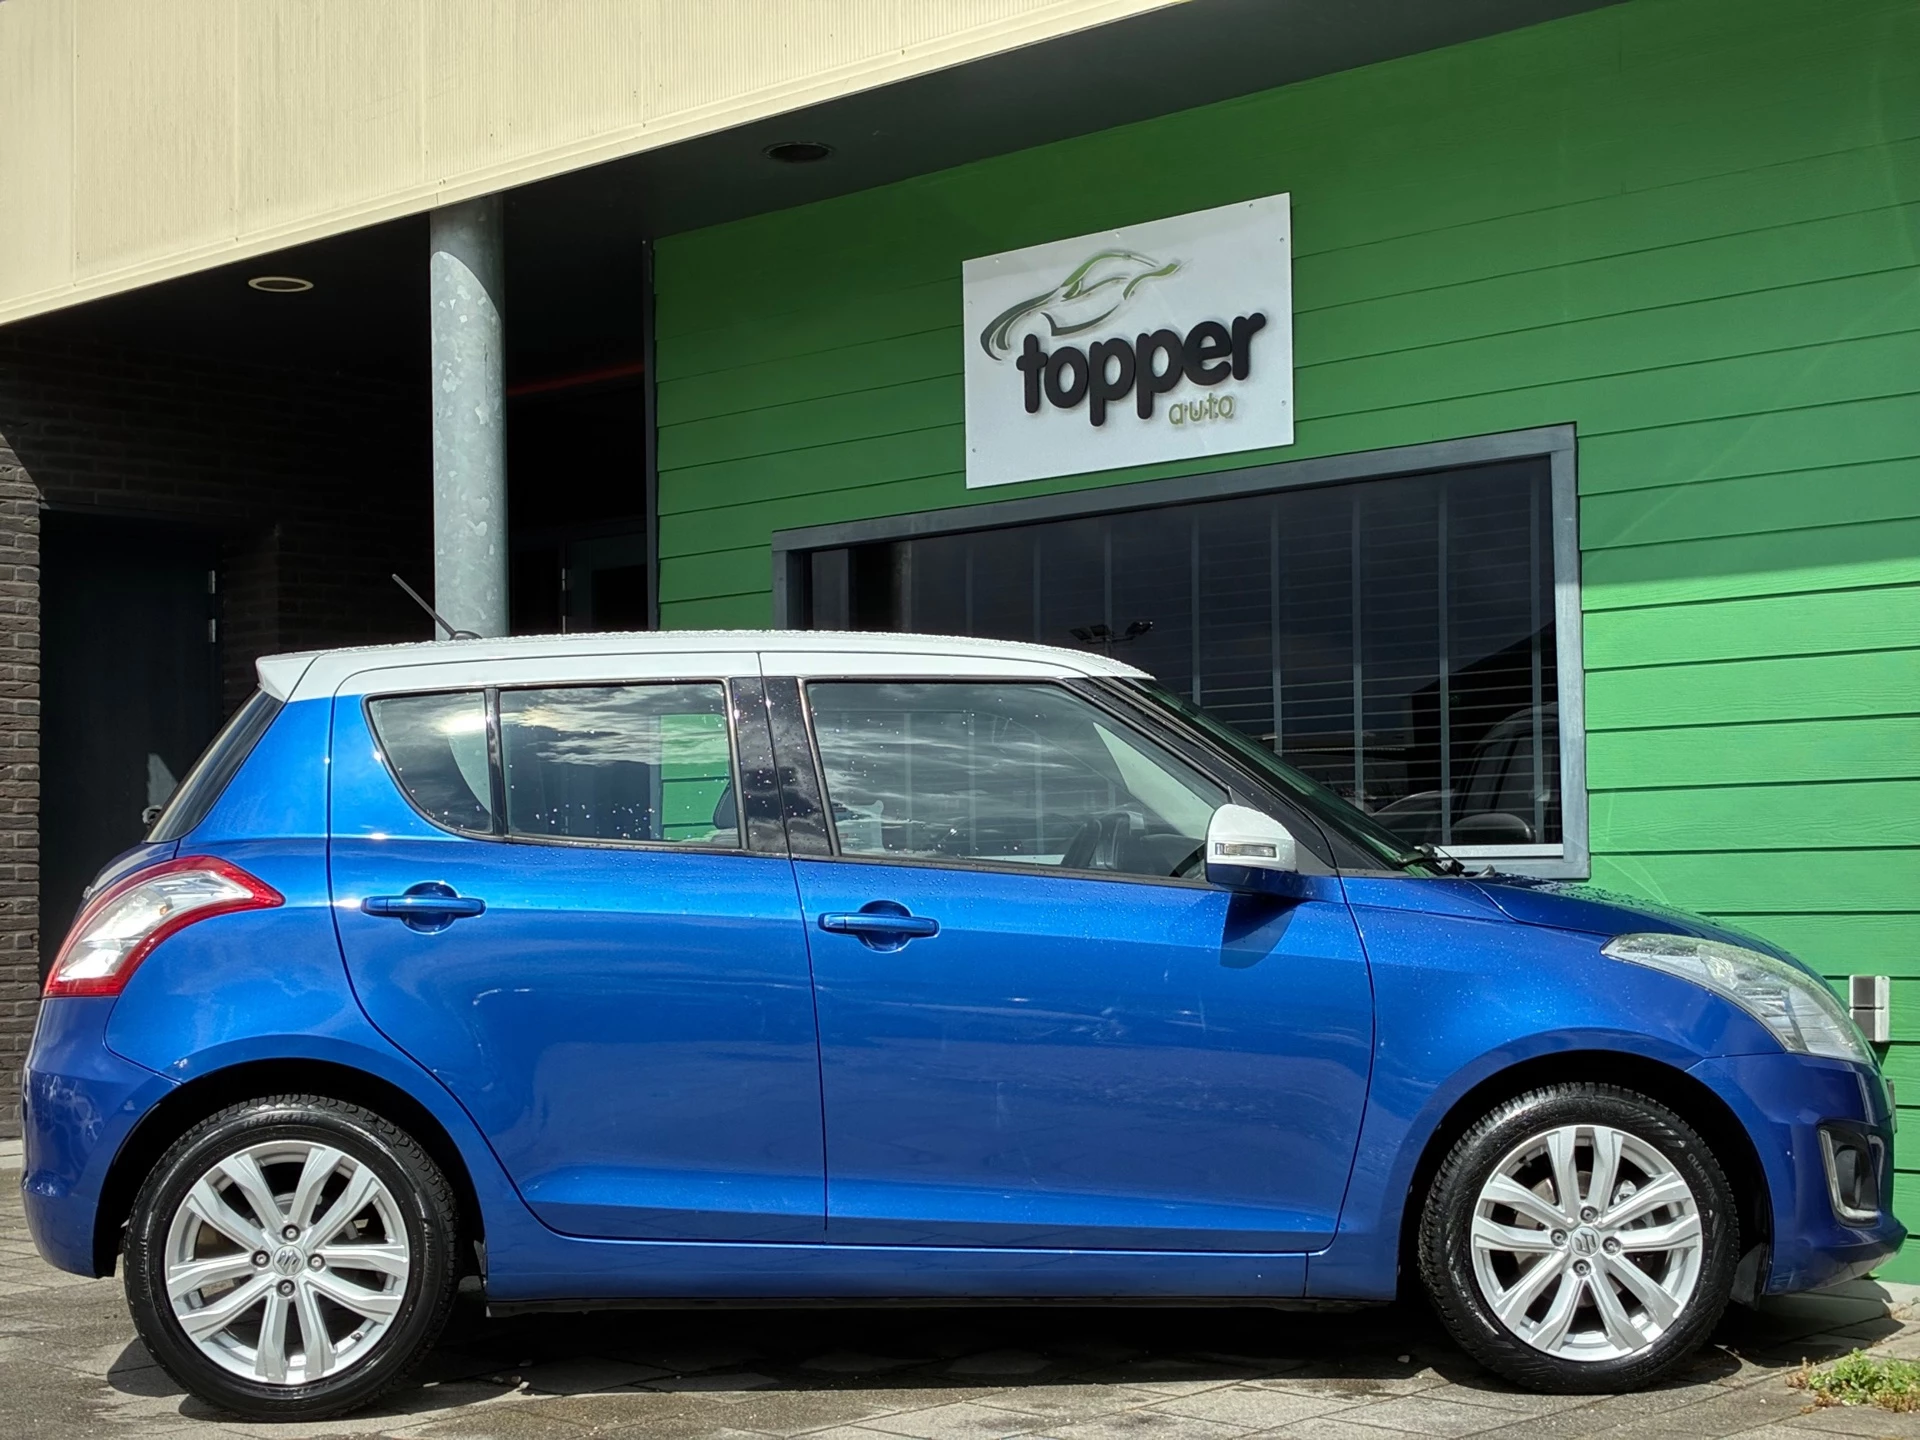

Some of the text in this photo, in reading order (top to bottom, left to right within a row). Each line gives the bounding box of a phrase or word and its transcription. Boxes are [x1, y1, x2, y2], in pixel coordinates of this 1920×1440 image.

[1016, 312, 1266, 427] topper
[1169, 393, 1233, 425] auto
[1687, 1153, 1719, 1205] QUATRAC
